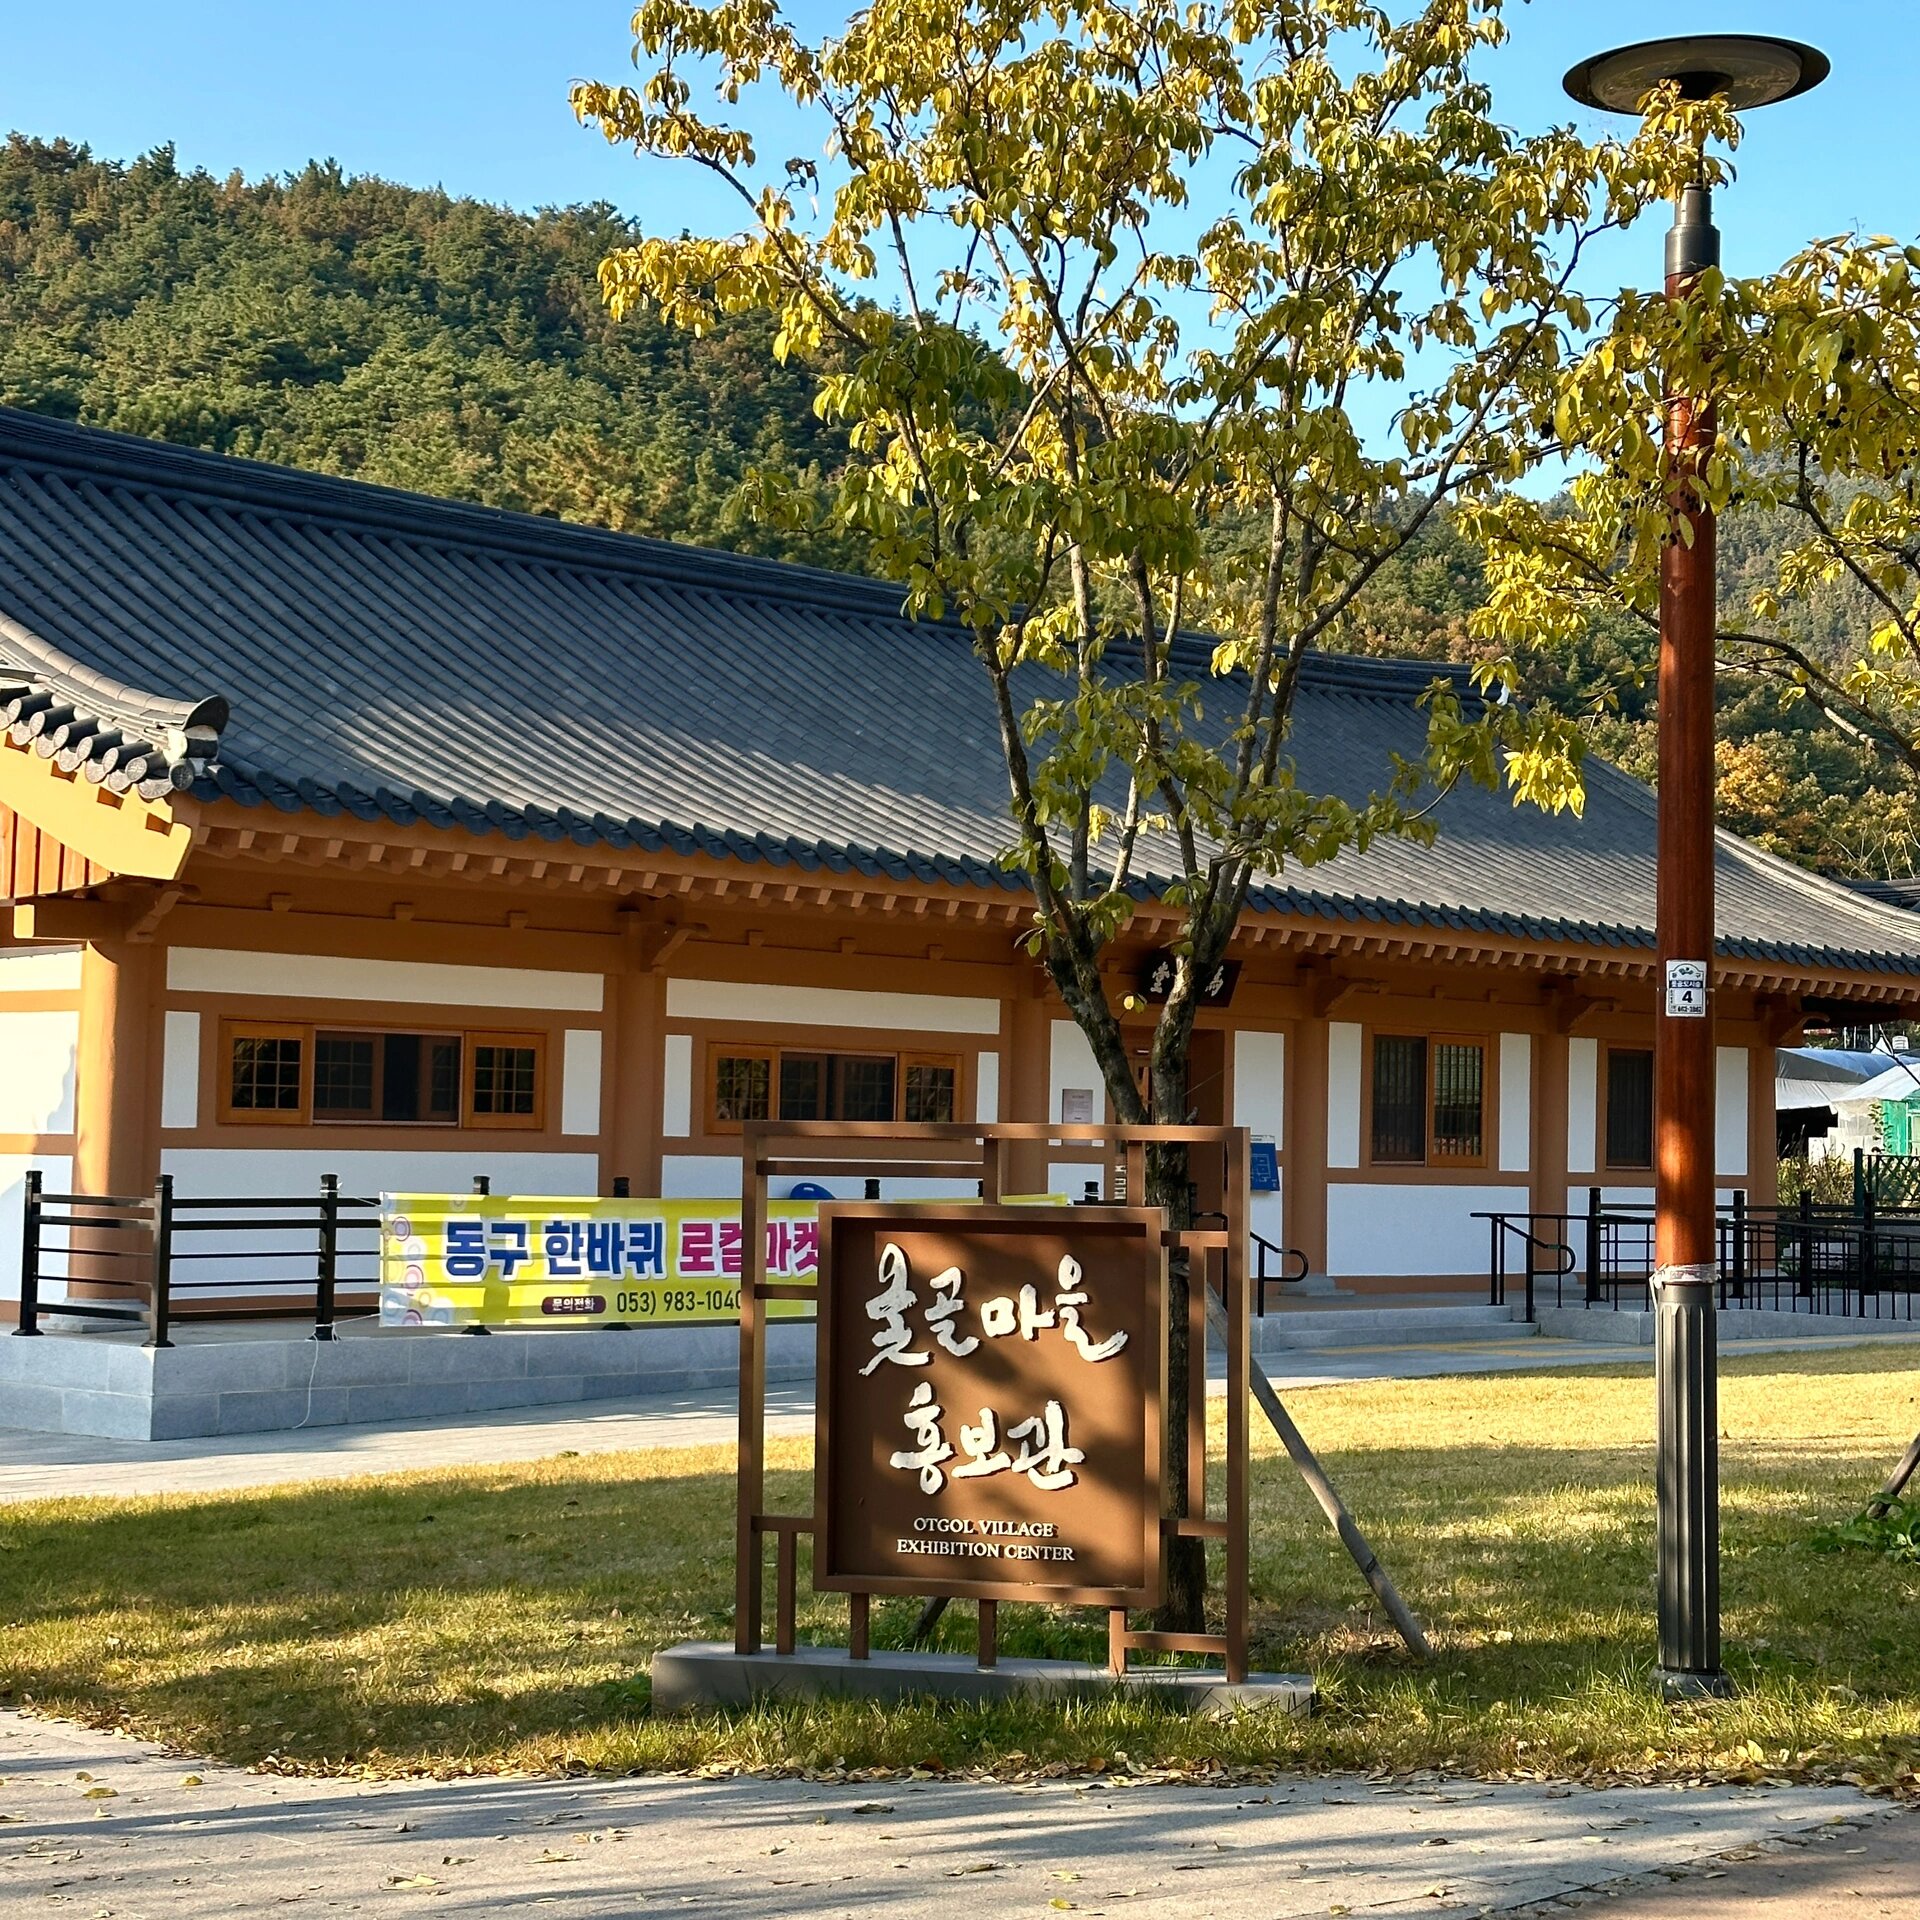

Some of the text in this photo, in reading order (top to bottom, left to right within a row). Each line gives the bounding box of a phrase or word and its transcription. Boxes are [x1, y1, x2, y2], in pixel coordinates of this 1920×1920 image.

[1682, 990, 1693, 1003] 4
[446, 1220, 529, 1277] 동구
[544, 1218, 664, 1276] 한바퀴
[552, 1297, 595, 1312] 문의전화
[616, 1290, 657, 1316] 053)
[889, 1380, 1086, 1496] 홍보관
[913, 1516, 1056, 1538] OTGOL VILLAGE
[896, 1538, 1075, 1562] EXHIBITION CENTER
